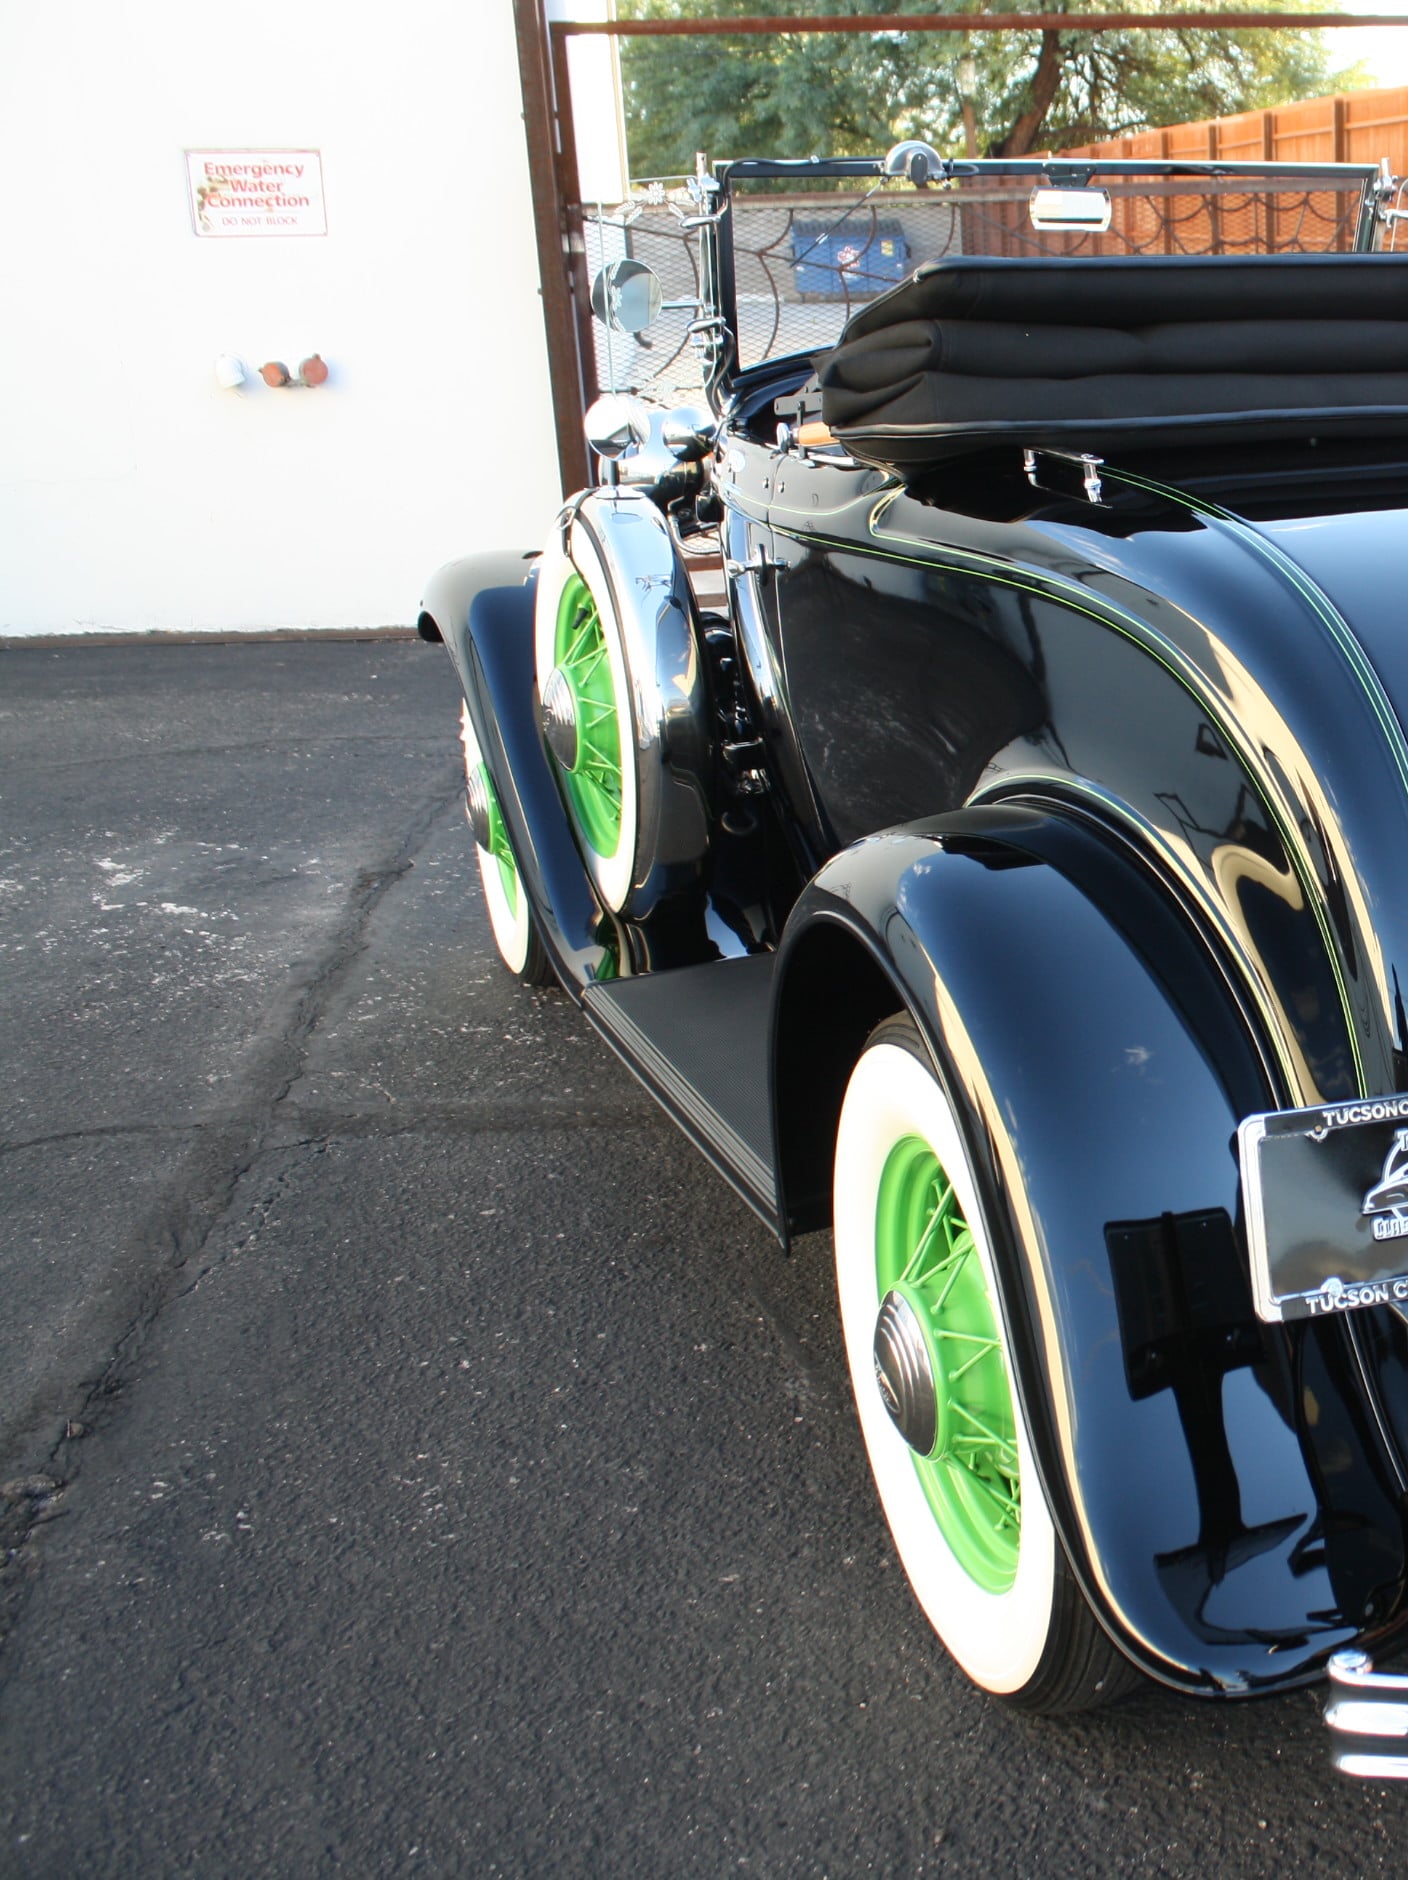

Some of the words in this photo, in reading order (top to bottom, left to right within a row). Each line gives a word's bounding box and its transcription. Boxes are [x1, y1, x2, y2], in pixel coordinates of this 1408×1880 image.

[204, 162, 304, 178] Emergency
[229, 180, 283, 192] Water
[207, 194, 309, 208] Connection
[222, 216, 238, 225] DO
[242, 216, 261, 225] NOT
[266, 216, 298, 225] BLOCK
[1305, 1283, 1389, 1314] TUCSON
